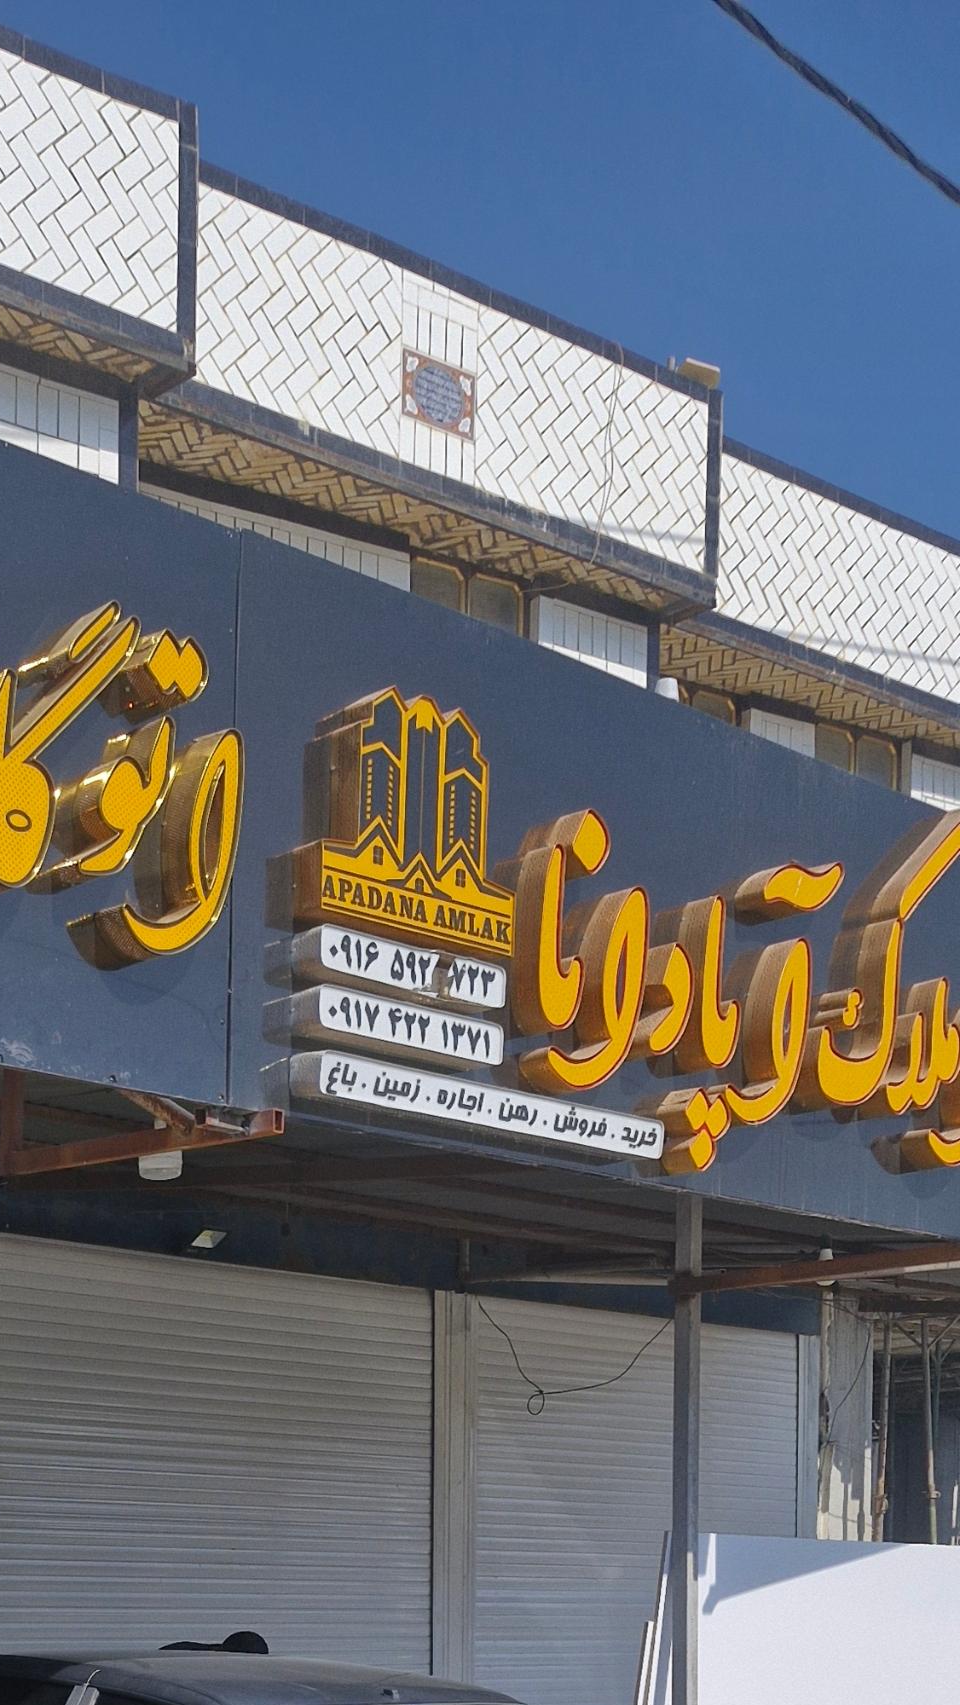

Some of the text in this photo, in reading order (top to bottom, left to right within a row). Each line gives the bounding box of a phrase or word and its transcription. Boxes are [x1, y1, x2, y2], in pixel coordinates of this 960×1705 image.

[321, 874, 511, 945] APADANA AMLAK
[329, 934, 496, 998] ۰۹۱۶ ۵۹۲ ۷۲۳
[328, 996, 491, 1058] ۰۹۱۷ ۴۲۲ ۱۳۷۱
[325, 1060, 658, 1150] خرید فروش رهن اجاره زمین باغ
